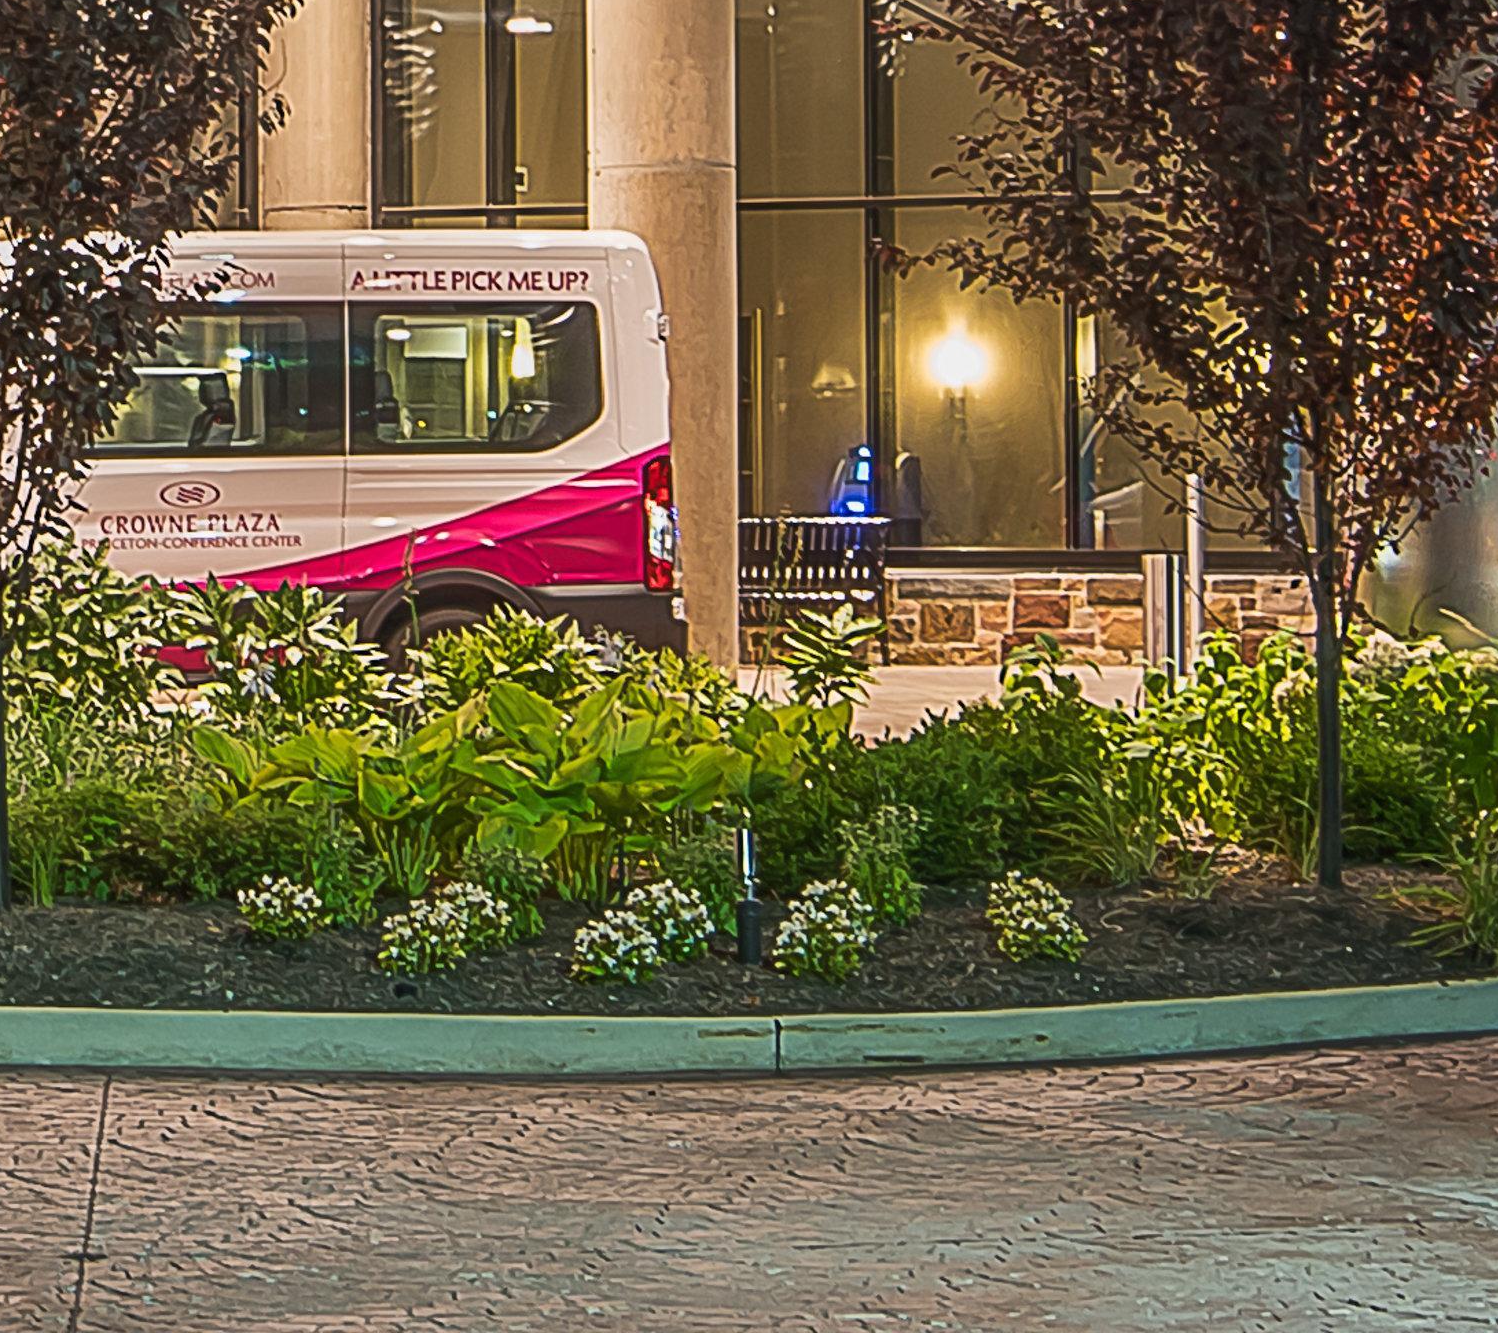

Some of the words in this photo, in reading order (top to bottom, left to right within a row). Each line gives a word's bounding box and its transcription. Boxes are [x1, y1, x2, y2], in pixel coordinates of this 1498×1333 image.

[350, 271, 368, 291] A
[372, 270, 447, 291] LITTLE
[451, 271, 503, 291] PICK
[507, 271, 544, 291] ME
[547, 271, 590, 292] UP?
[100, 514, 198, 534] CROWNE
[207, 513, 281, 533] PLAZA
[81, 536, 249, 550] PRCETON-CONFERENCE
[252, 535, 302, 548] CENTER
